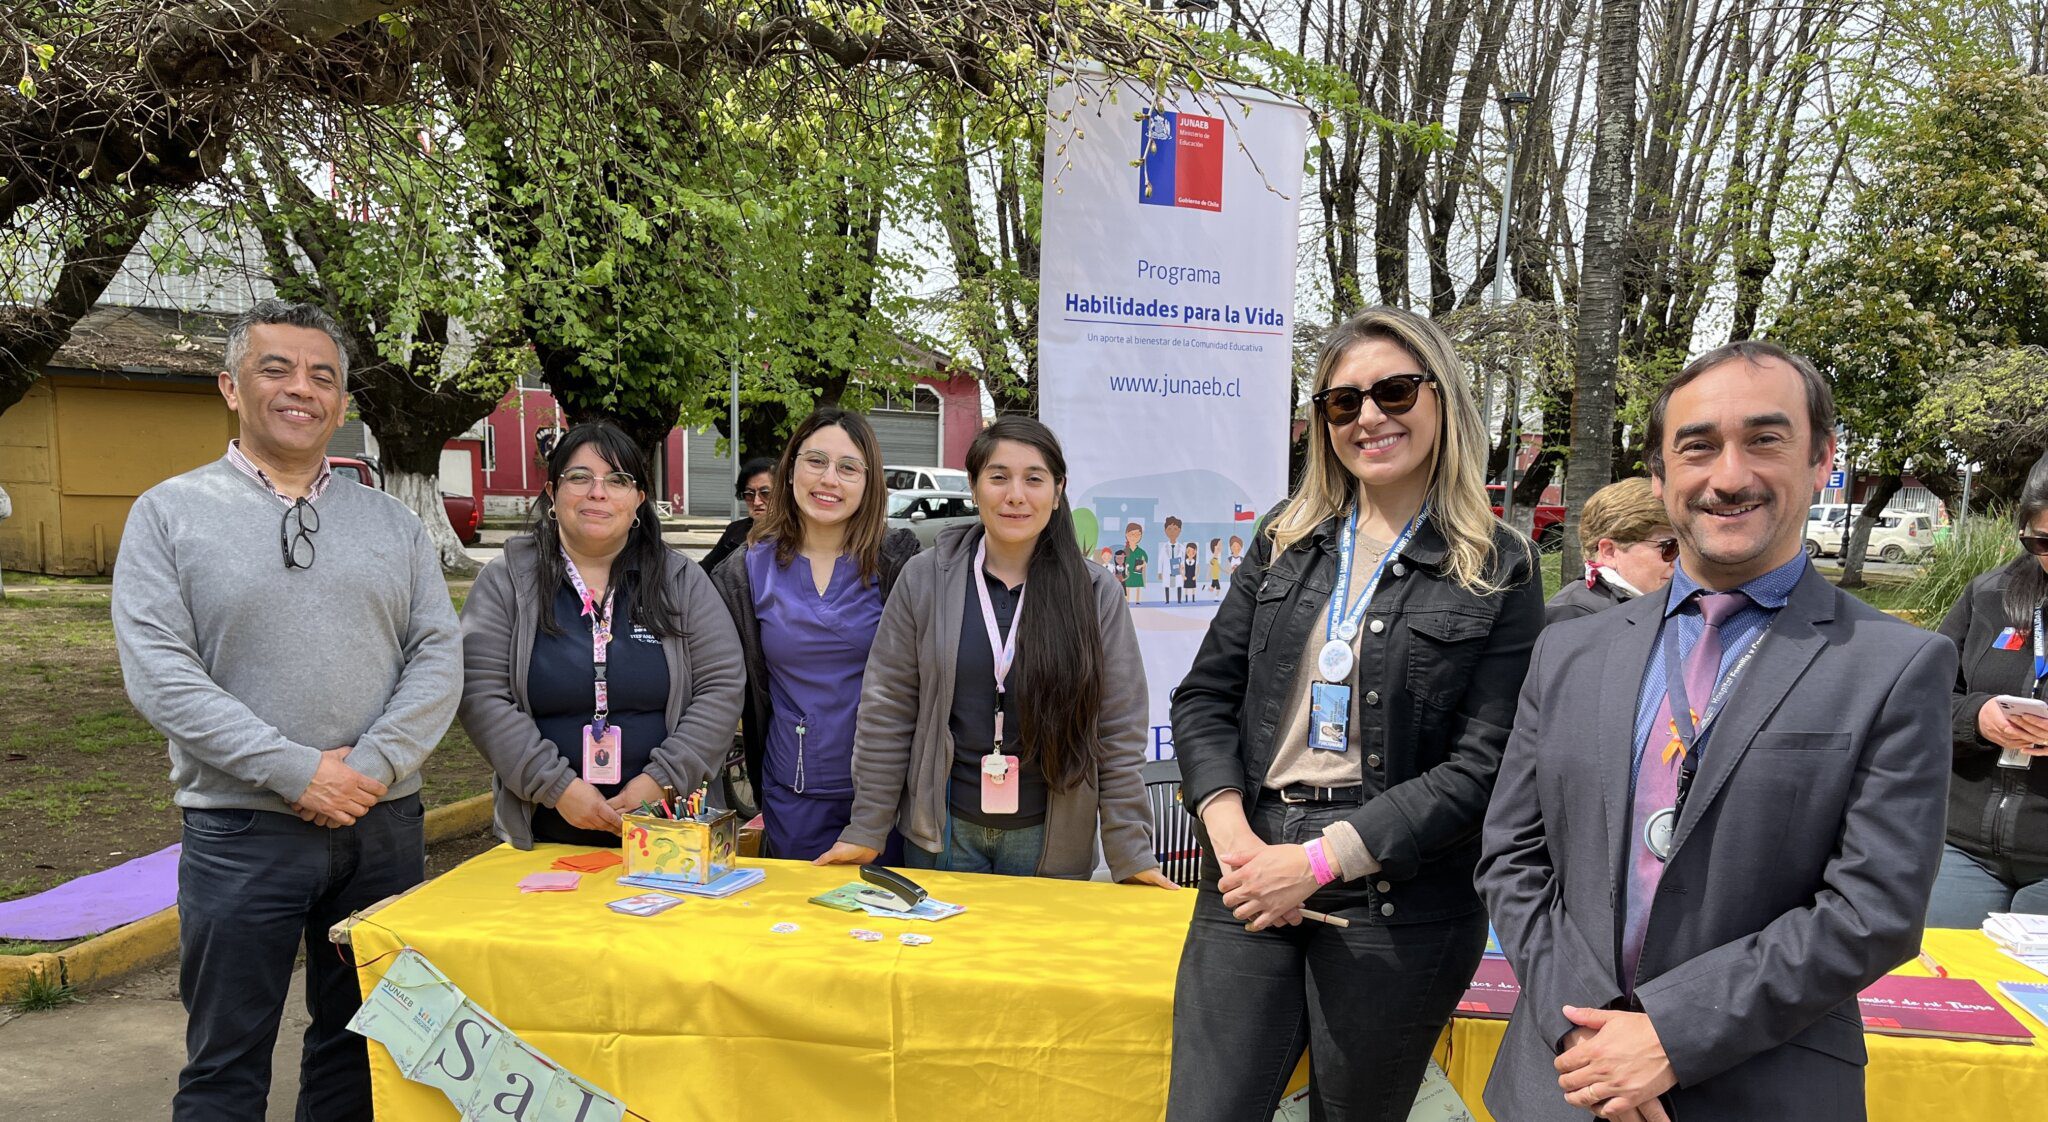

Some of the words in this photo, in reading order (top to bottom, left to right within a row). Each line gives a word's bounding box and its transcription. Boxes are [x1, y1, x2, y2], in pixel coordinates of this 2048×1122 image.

[1180, 118, 1209, 130] JUNAEB
[1180, 130, 1204, 138] Ministerio
[1180, 139, 1204, 148] Educación
[1178, 197, 1200, 206] Gobierno
[1207, 200, 1220, 208] Chile
[1138, 260, 1221, 286] Programa
[1066, 293, 1179, 318] Habilidades
[1184, 305, 1220, 324] para
[1226, 304, 1240, 324] la
[1245, 307, 1284, 326] Vida
[1088, 333, 1098, 342] Un
[1100, 334, 1124, 344] aporte
[1125, 336, 1133, 344] al
[1134, 336, 1170, 346] bienestar
[1172, 338, 1181, 346] de
[1183, 338, 1190, 347] la
[1191, 338, 1228, 350] Comunidad
[1230, 342, 1263, 352] Educativa
[1110, 374, 1241, 398] www.junaeb.cl
[1830, 474, 1840, 486] E
[1393, 536, 1409, 554] SANTA
[1330, 597, 1342, 640] MUNICIPALIDAD
[1336, 573, 1346, 589] SANTA
[1712, 677, 1735, 704] Hospital
[1729, 654, 1751, 678] Familia
[384, 981, 414, 1008] JUNAEB
[1944, 1000, 1996, 1012] Tierra
